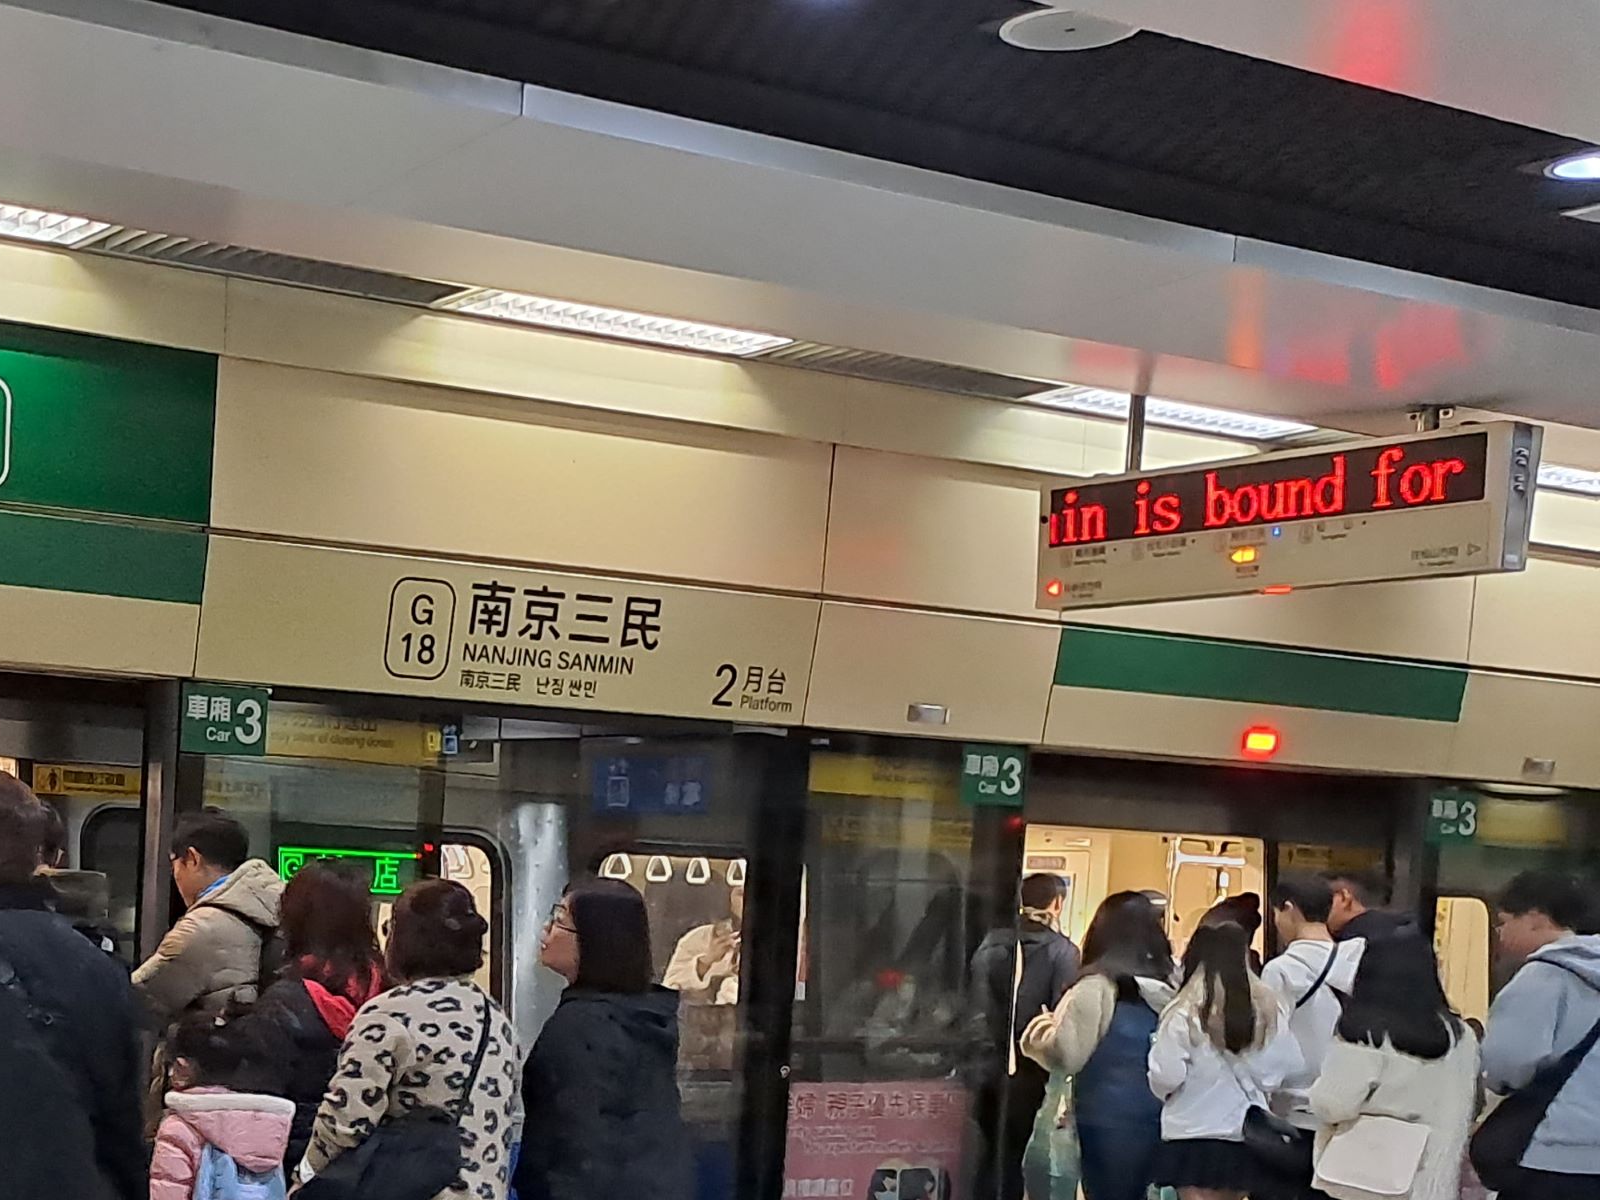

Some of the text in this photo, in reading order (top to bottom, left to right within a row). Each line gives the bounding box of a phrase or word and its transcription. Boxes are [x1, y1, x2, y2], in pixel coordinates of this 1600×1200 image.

[1134, 479, 1181, 535] is
[1204, 452, 1345, 527] bound
[1370, 446, 1466, 508] for
[410, 593, 435, 625] G
[468, 580, 662, 651] 南京三民
[400, 632, 436, 665] 18
[462, 642, 635, 675] NANJING SANMIN
[460, 669, 522, 692] 南京三民
[536, 676, 564, 696] 난징
[712, 663, 787, 707] 2 月台
[186, 694, 232, 722] 車廂
[234, 698, 262, 745] 3
[740, 694, 793, 713] Platform
[206, 726, 232, 742] Car
[1001, 756, 1022, 796] 3
[1458, 800, 1477, 836] 3
